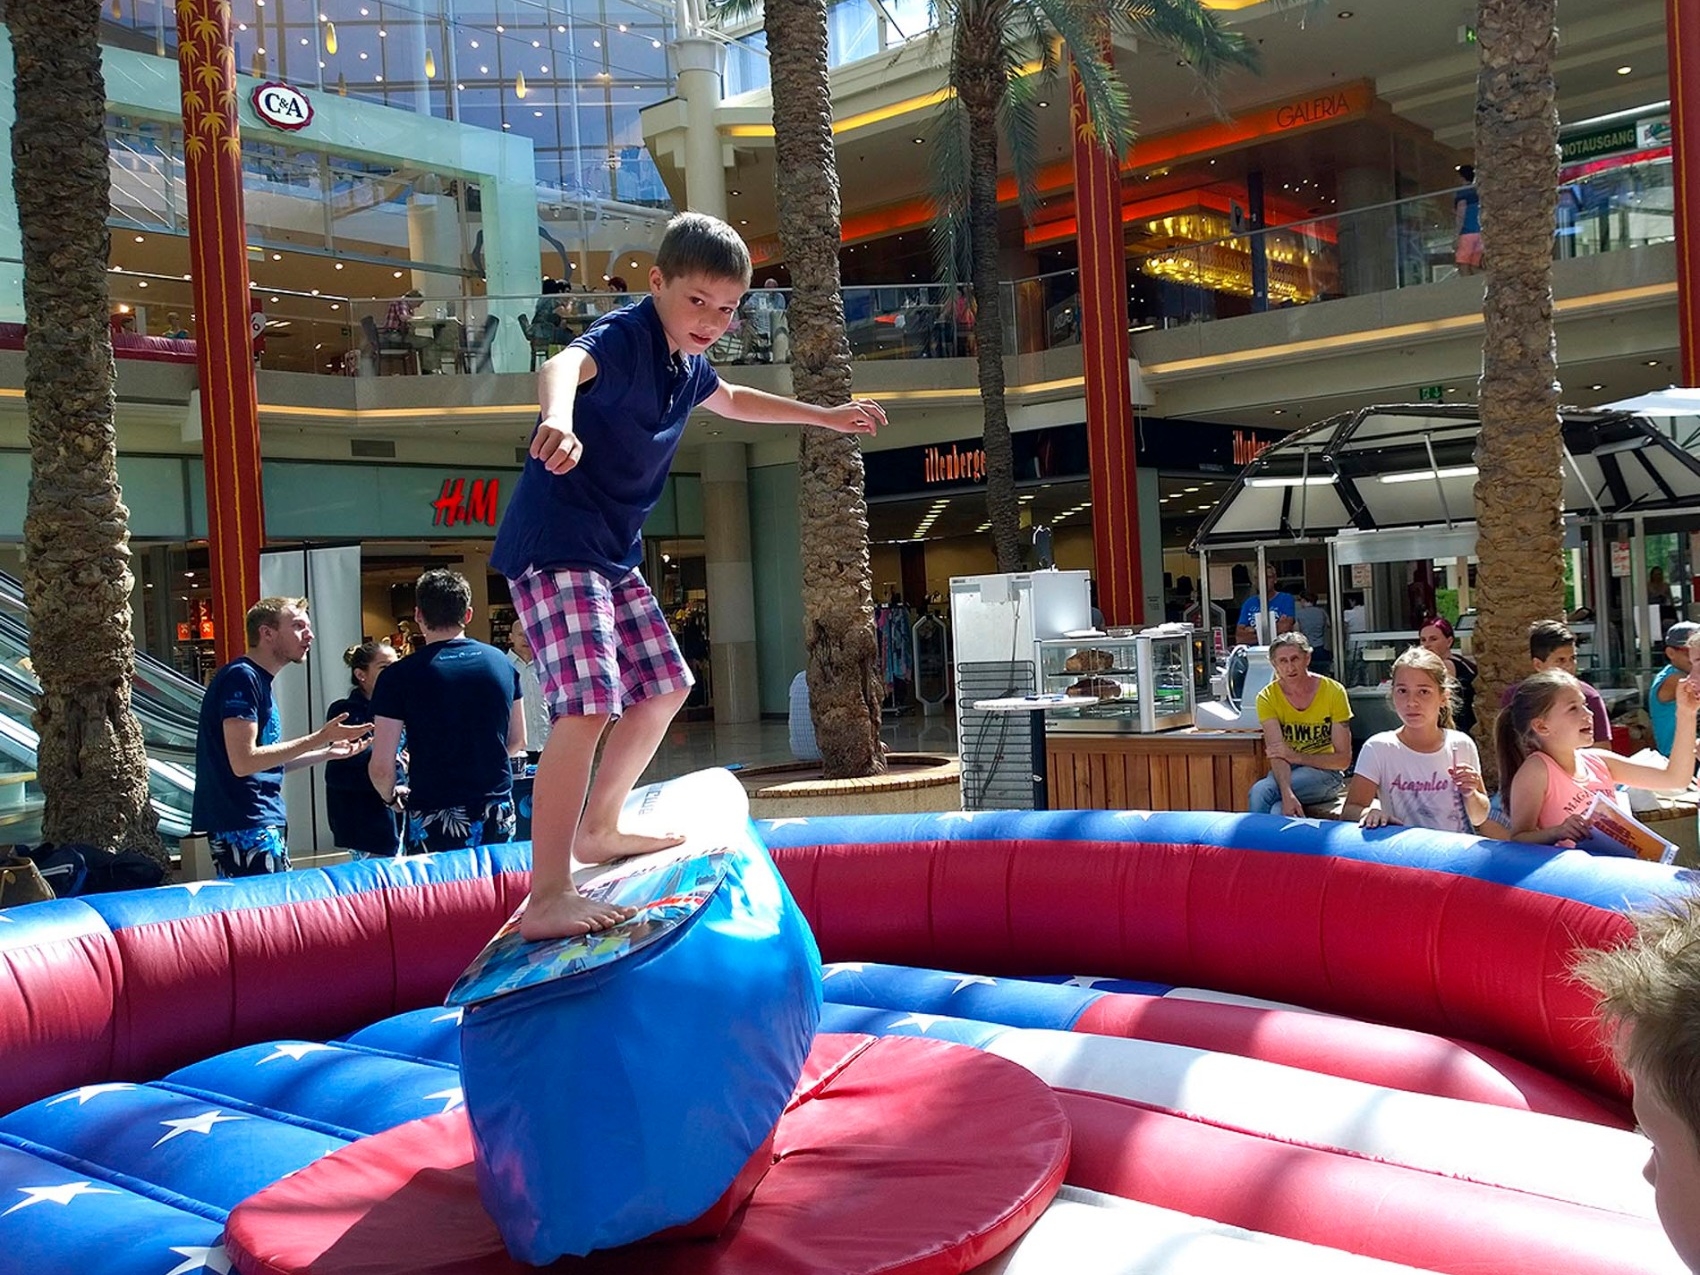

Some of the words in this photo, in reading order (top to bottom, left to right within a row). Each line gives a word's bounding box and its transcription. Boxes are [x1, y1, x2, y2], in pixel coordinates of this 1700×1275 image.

[264, 92, 304, 119] C&A
[1276, 92, 1351, 128] GALERIA
[1561, 128, 1635, 156] NOTAUSGANG
[924, 444, 988, 483] illenberge
[431, 477, 500, 527] H&M
